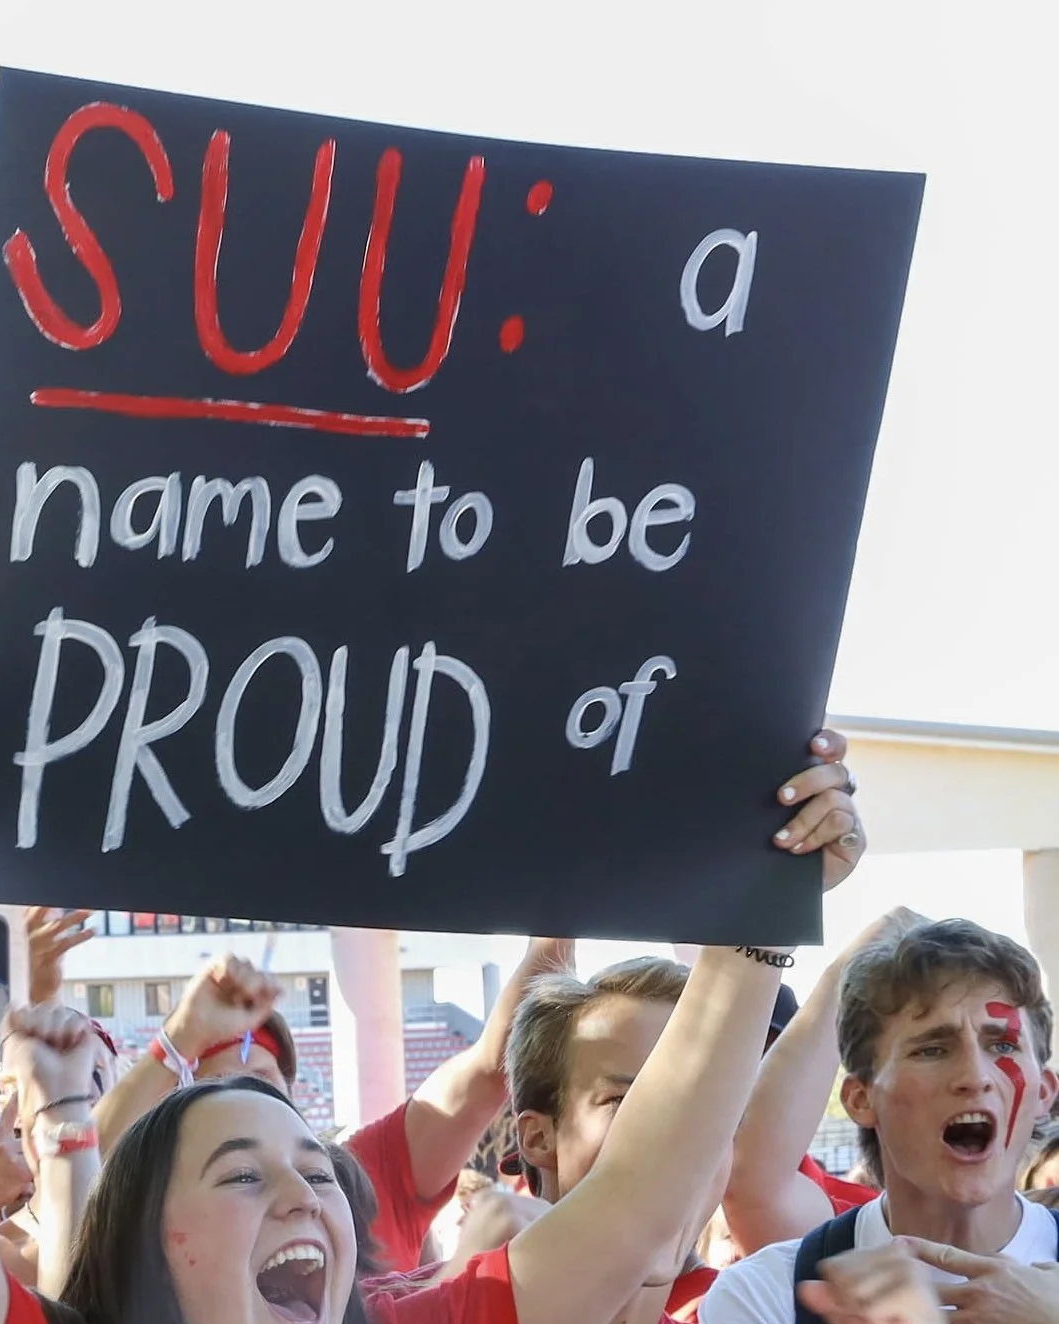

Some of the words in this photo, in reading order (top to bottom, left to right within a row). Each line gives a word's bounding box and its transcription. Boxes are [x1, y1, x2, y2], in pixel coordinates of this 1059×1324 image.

[2, 101, 554, 394] SUU:
[679, 228, 758, 338] a
[9, 461, 343, 569] name
[393, 460, 494, 573] to
[562, 457, 697, 572] be
[13, 606, 491, 877] PROUD
[565, 655, 677, 776] of
